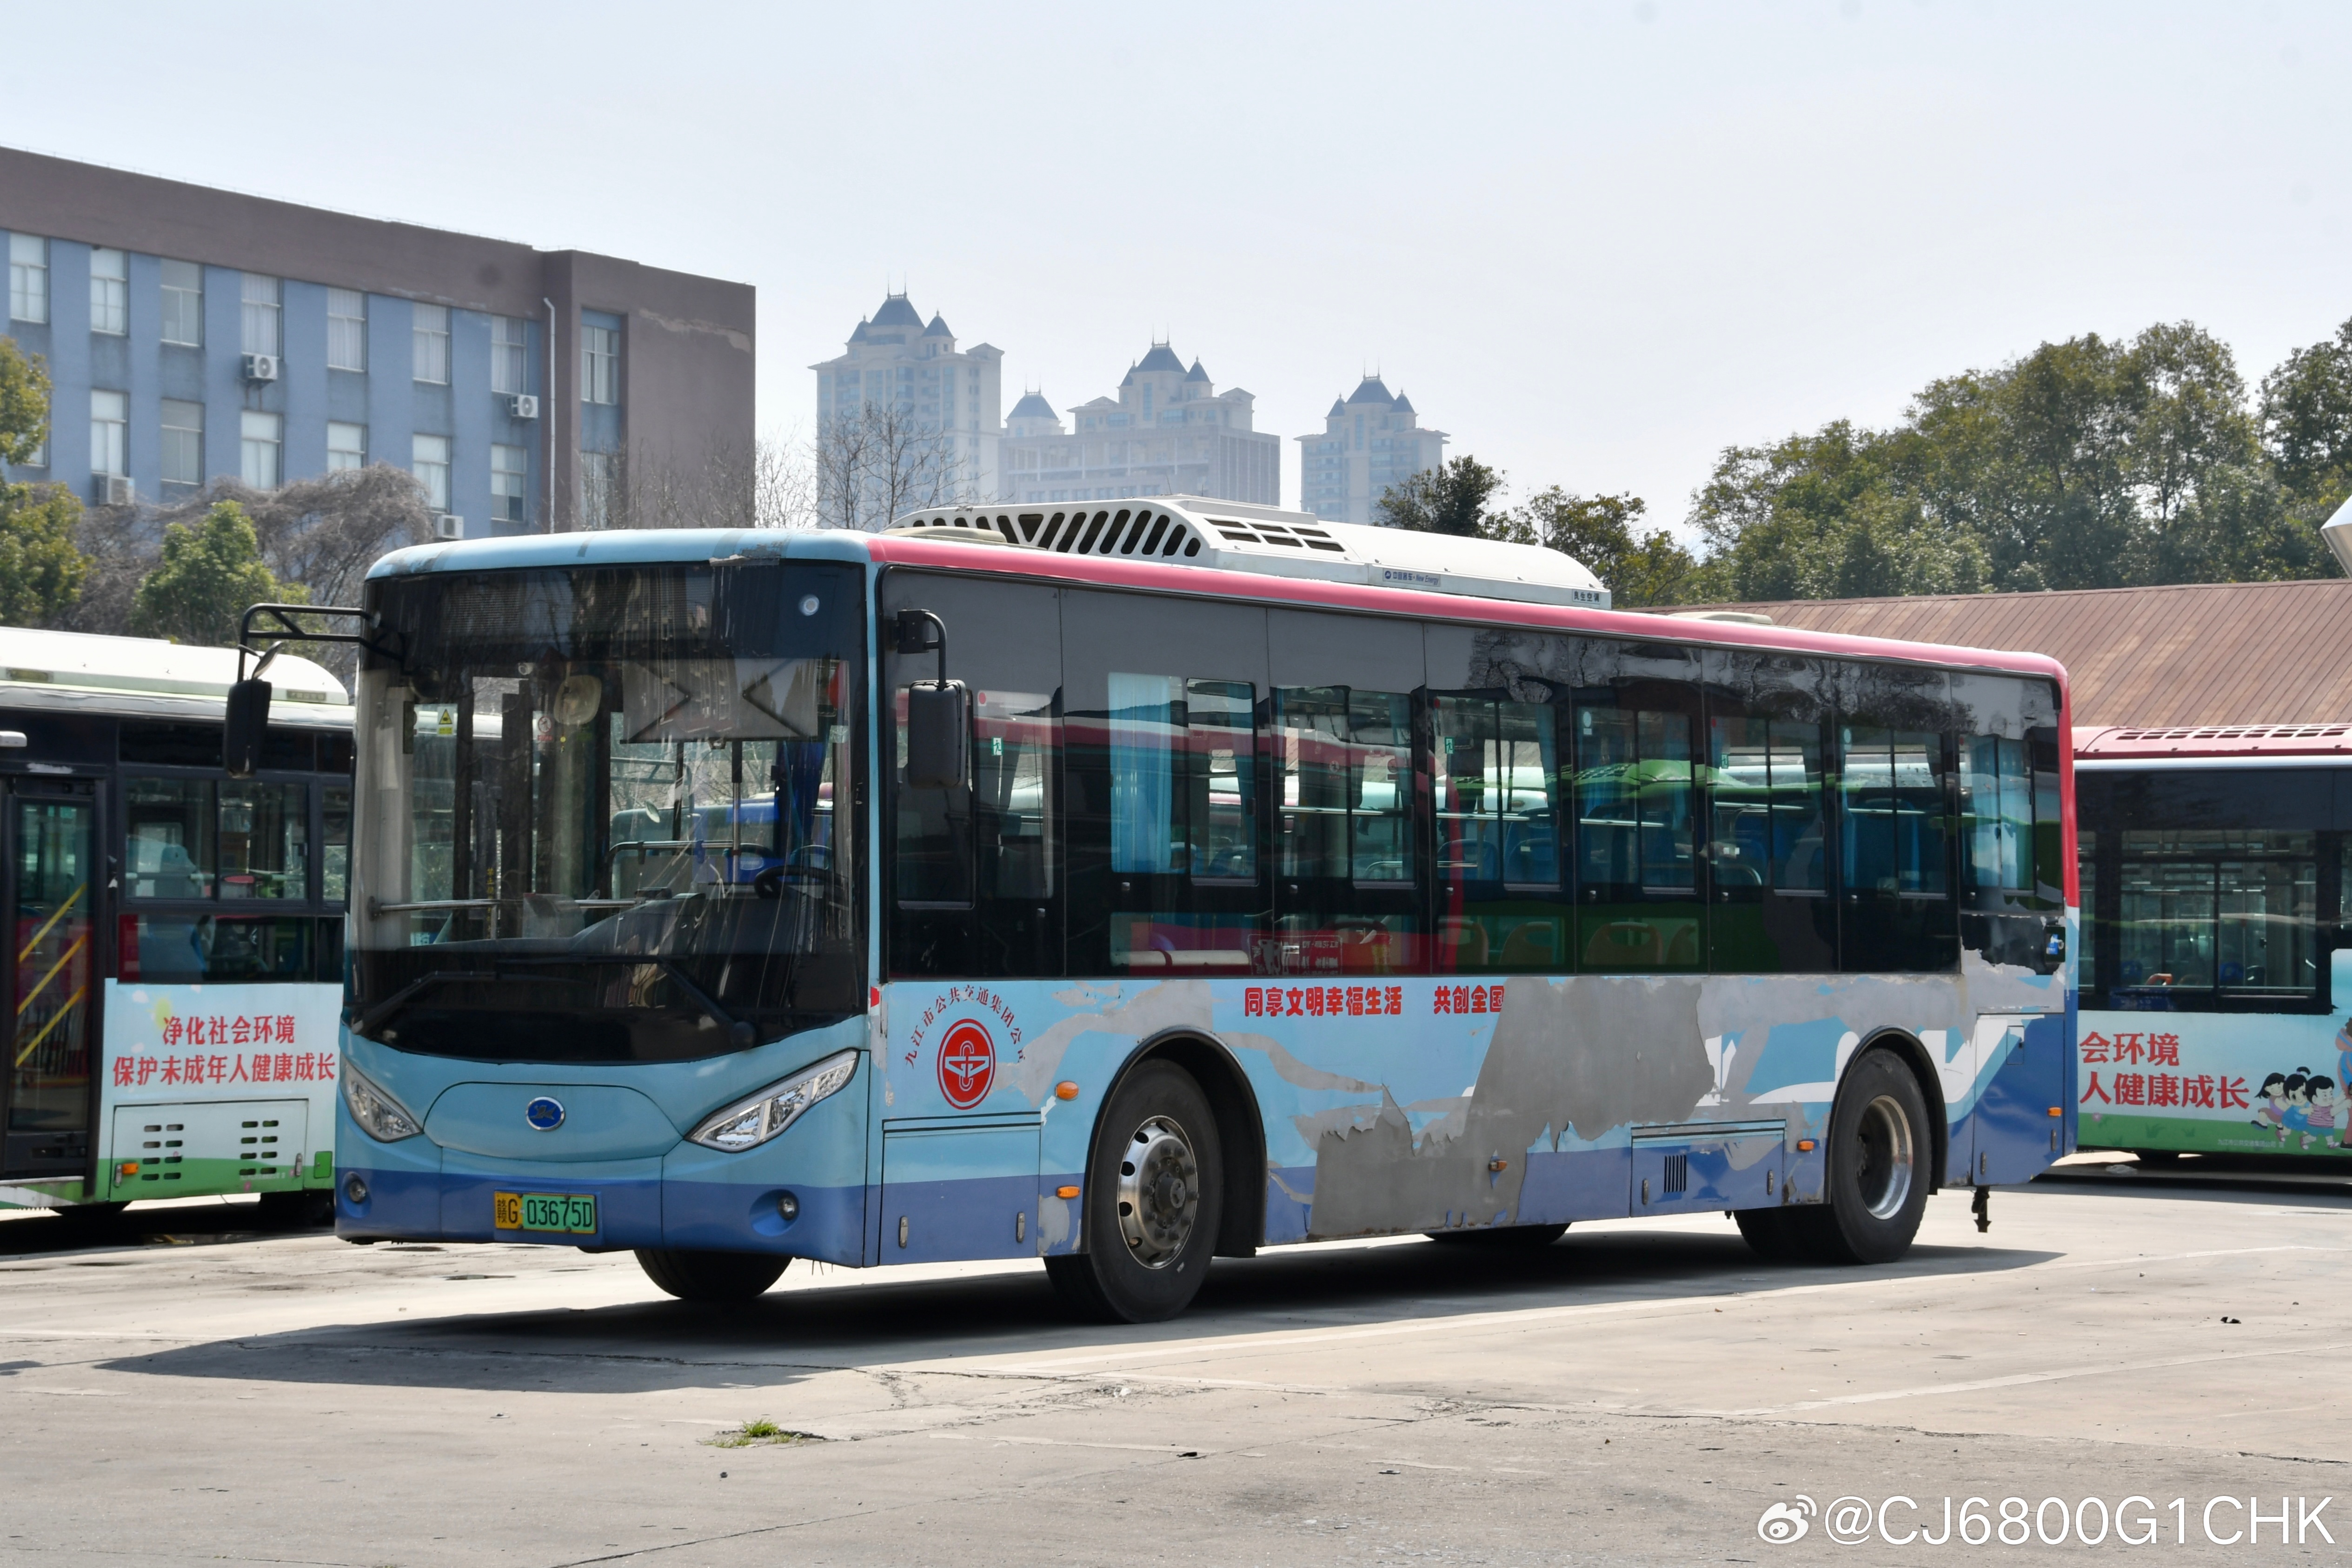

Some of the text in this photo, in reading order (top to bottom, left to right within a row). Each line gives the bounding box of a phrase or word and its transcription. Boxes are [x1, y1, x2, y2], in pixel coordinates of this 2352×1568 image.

[1424, 575, 1439, 585] Energy
[1574, 590, 1599, 603] 良生空调
[1245, 985, 1505, 1017] 同享文明幸福生活 共创全国
[163, 1015, 295, 1045] 净化社会环境
[2079, 1031, 2179, 1066] 会环境
[113, 1052, 336, 1087] 保护未成年人健康成长
[2080, 1071, 2250, 1110] 人健康成长
[527, 1199, 592, 1228] 03675D
